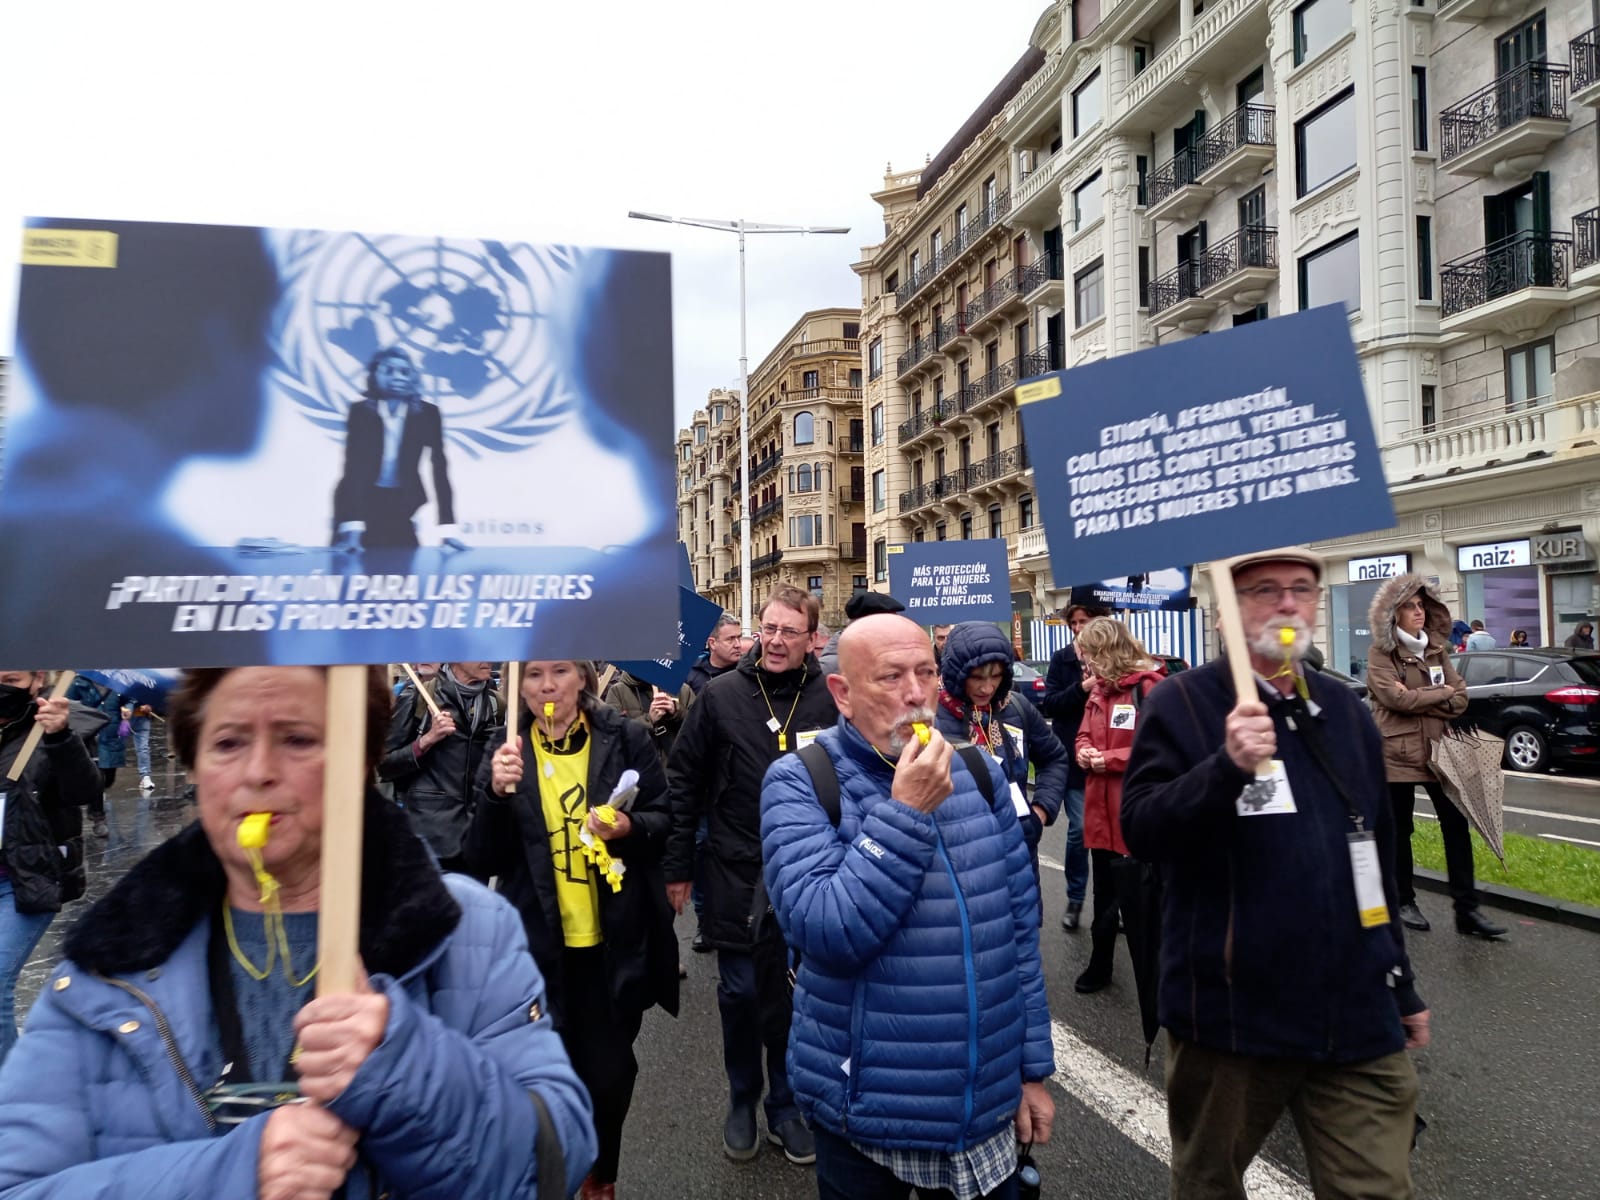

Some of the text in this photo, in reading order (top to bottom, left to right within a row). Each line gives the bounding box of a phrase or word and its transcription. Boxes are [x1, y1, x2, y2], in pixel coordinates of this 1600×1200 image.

[1100, 386, 1292, 447] ETIOPÍA, AFGANISTÁN,
[1066, 439, 1160, 476] COLOMBIA,
[1162, 420, 1247, 454] UCRANIA,
[1068, 419, 1347, 496] TODOS LOS CONFLICTOS TIENEN
[1070, 441, 1357, 518] CONSECUENCIAS DEVASTADORAS
[1074, 465, 1360, 539] PARA LAS MUJERES Y LAS NIÑAS.
[461, 519, 545, 534] ations
[1473, 546, 1515, 567] naiz:
[1535, 538, 1579, 559] KUR
[913, 562, 986, 576] MÁS PROTECCIÓN
[1358, 559, 1396, 579] naiz:
[105, 569, 594, 609] ¡PARTICIPACIÓN PARA LAS MUJERES
[911, 574, 990, 587] PARA LAS MUJERES
[935, 584, 968, 596] Y NIÑAS
[909, 594, 995, 607] EN LOS CONFLICTOS.
[171, 602, 536, 632] EN LOS PROCESOS DE PAZ!
